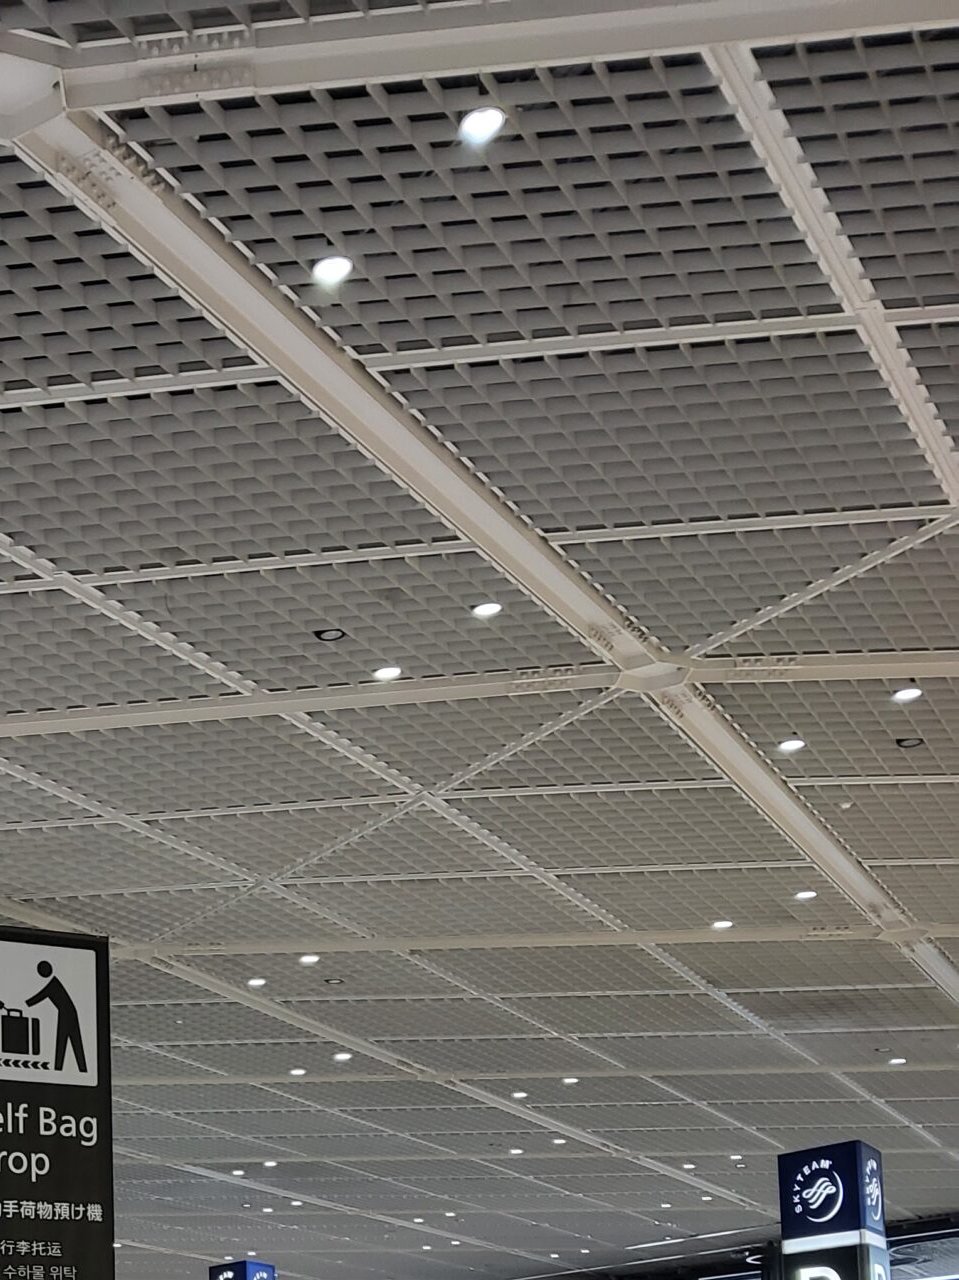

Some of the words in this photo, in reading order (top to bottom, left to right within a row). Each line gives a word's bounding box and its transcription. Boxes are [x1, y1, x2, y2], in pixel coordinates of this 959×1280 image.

[38, 1106, 98, 1146] Bag
[792, 1159, 832, 1214] SKYTEAM
[3, 1264, 46, 1280] 수하물
